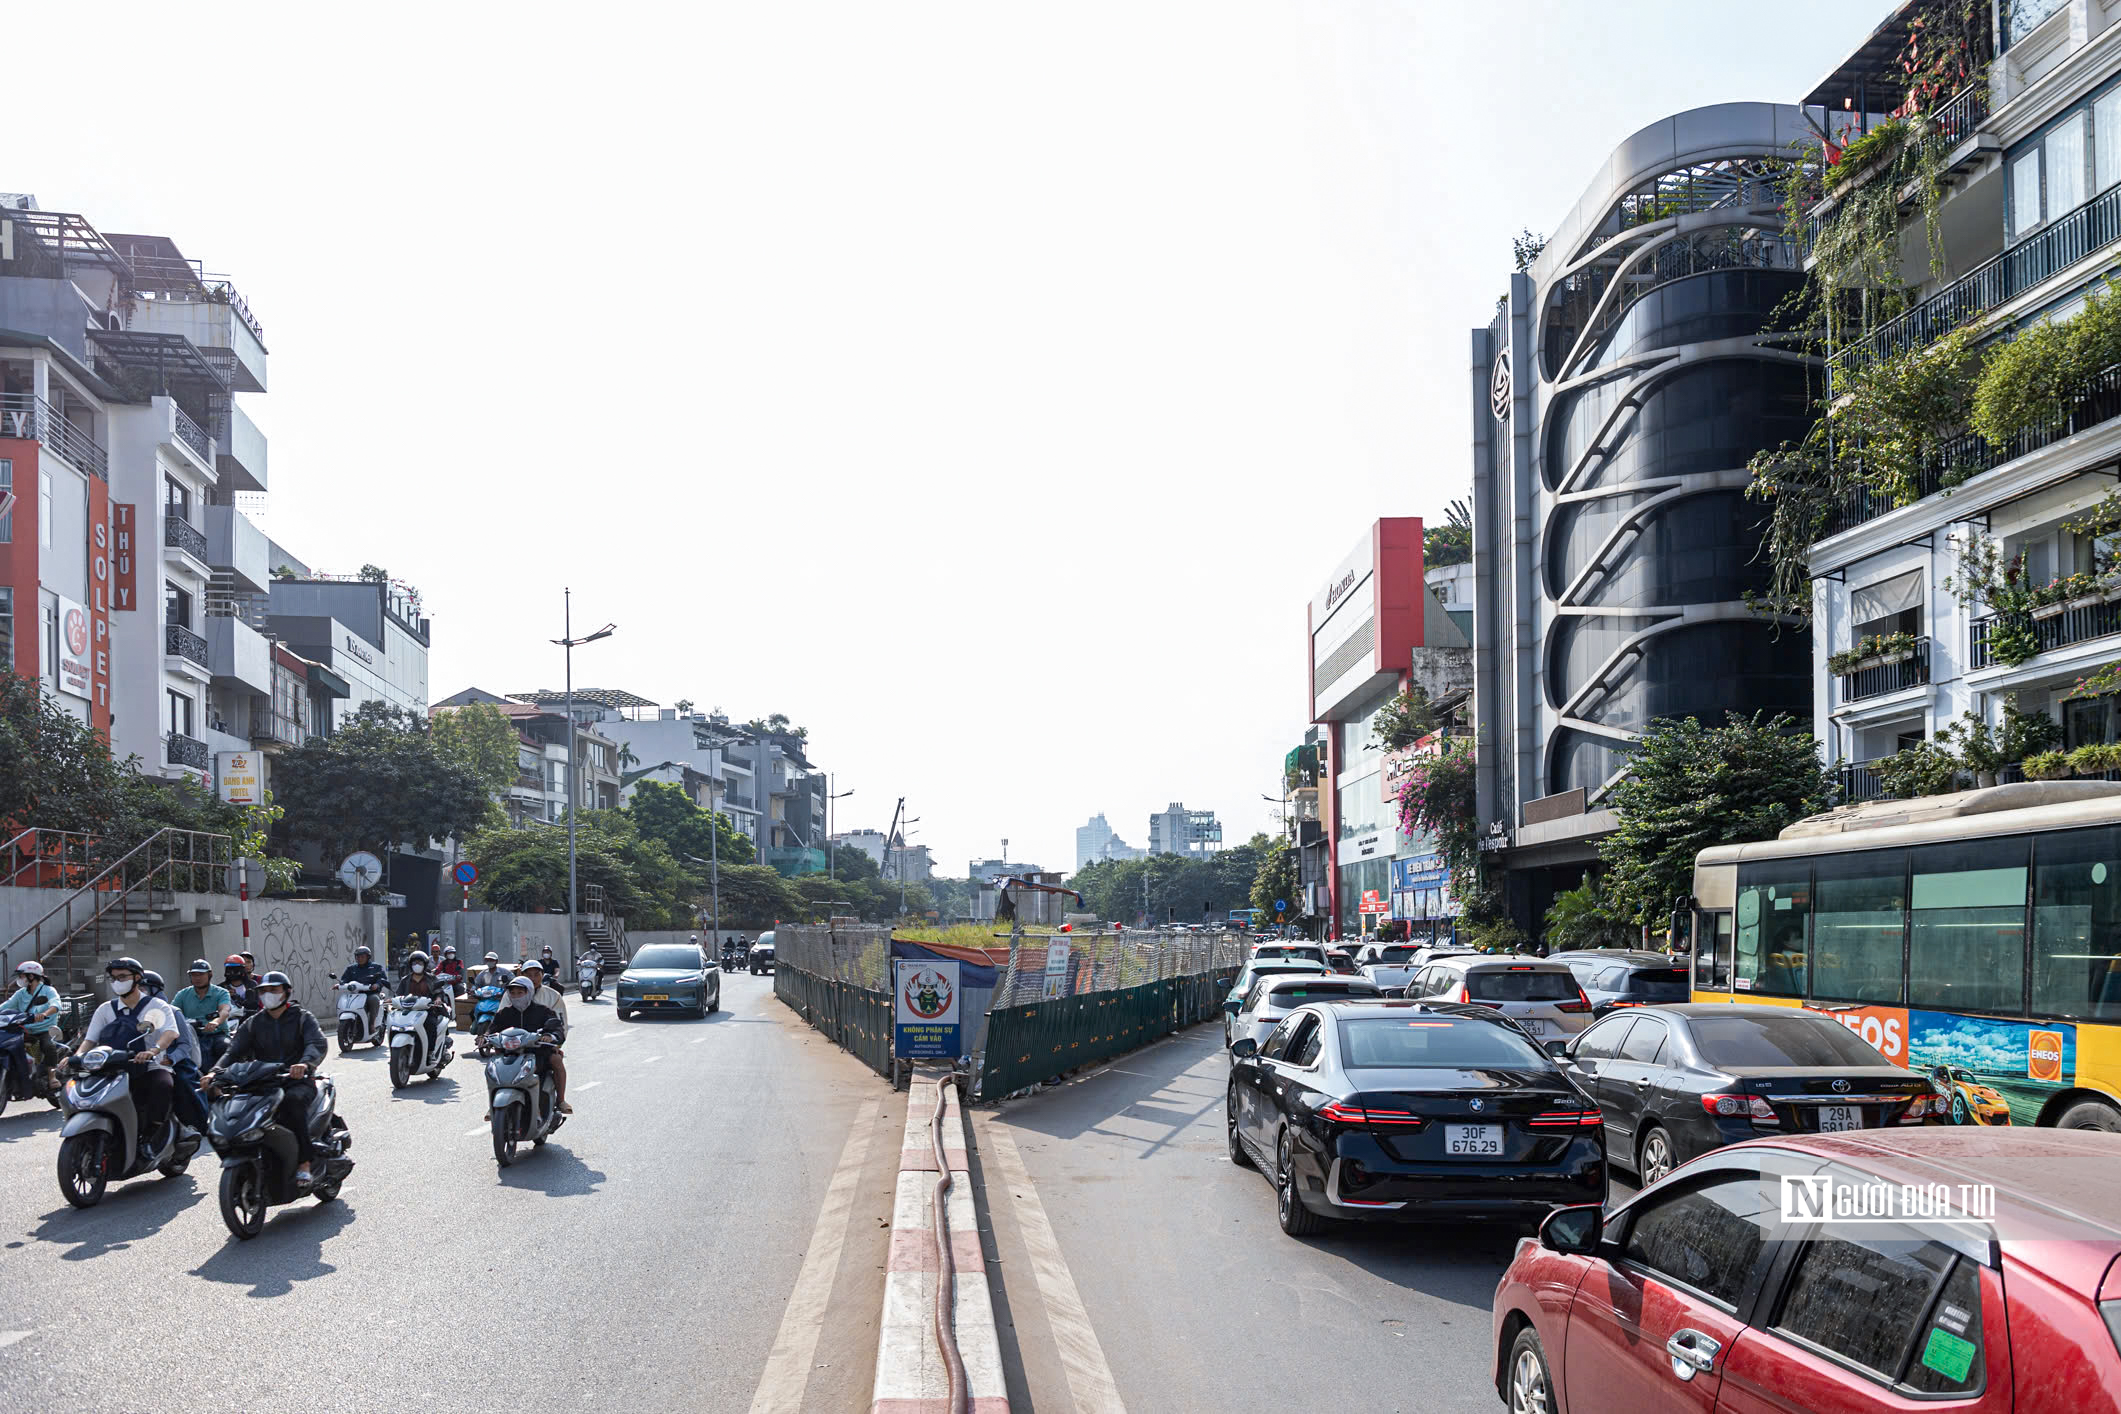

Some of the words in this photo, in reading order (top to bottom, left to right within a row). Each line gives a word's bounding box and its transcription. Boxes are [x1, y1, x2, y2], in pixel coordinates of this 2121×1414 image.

[119, 507, 129, 606] THÚY
[1332, 569, 1355, 604] HONDA
[94, 523, 107, 707] SOLPET
[2031, 1049, 2059, 1062] ENEOS
[1829, 1107, 1852, 1121] 29A
[1462, 1127, 1487, 1139] 30F
[1452, 1140, 1497, 1153] 676.29
